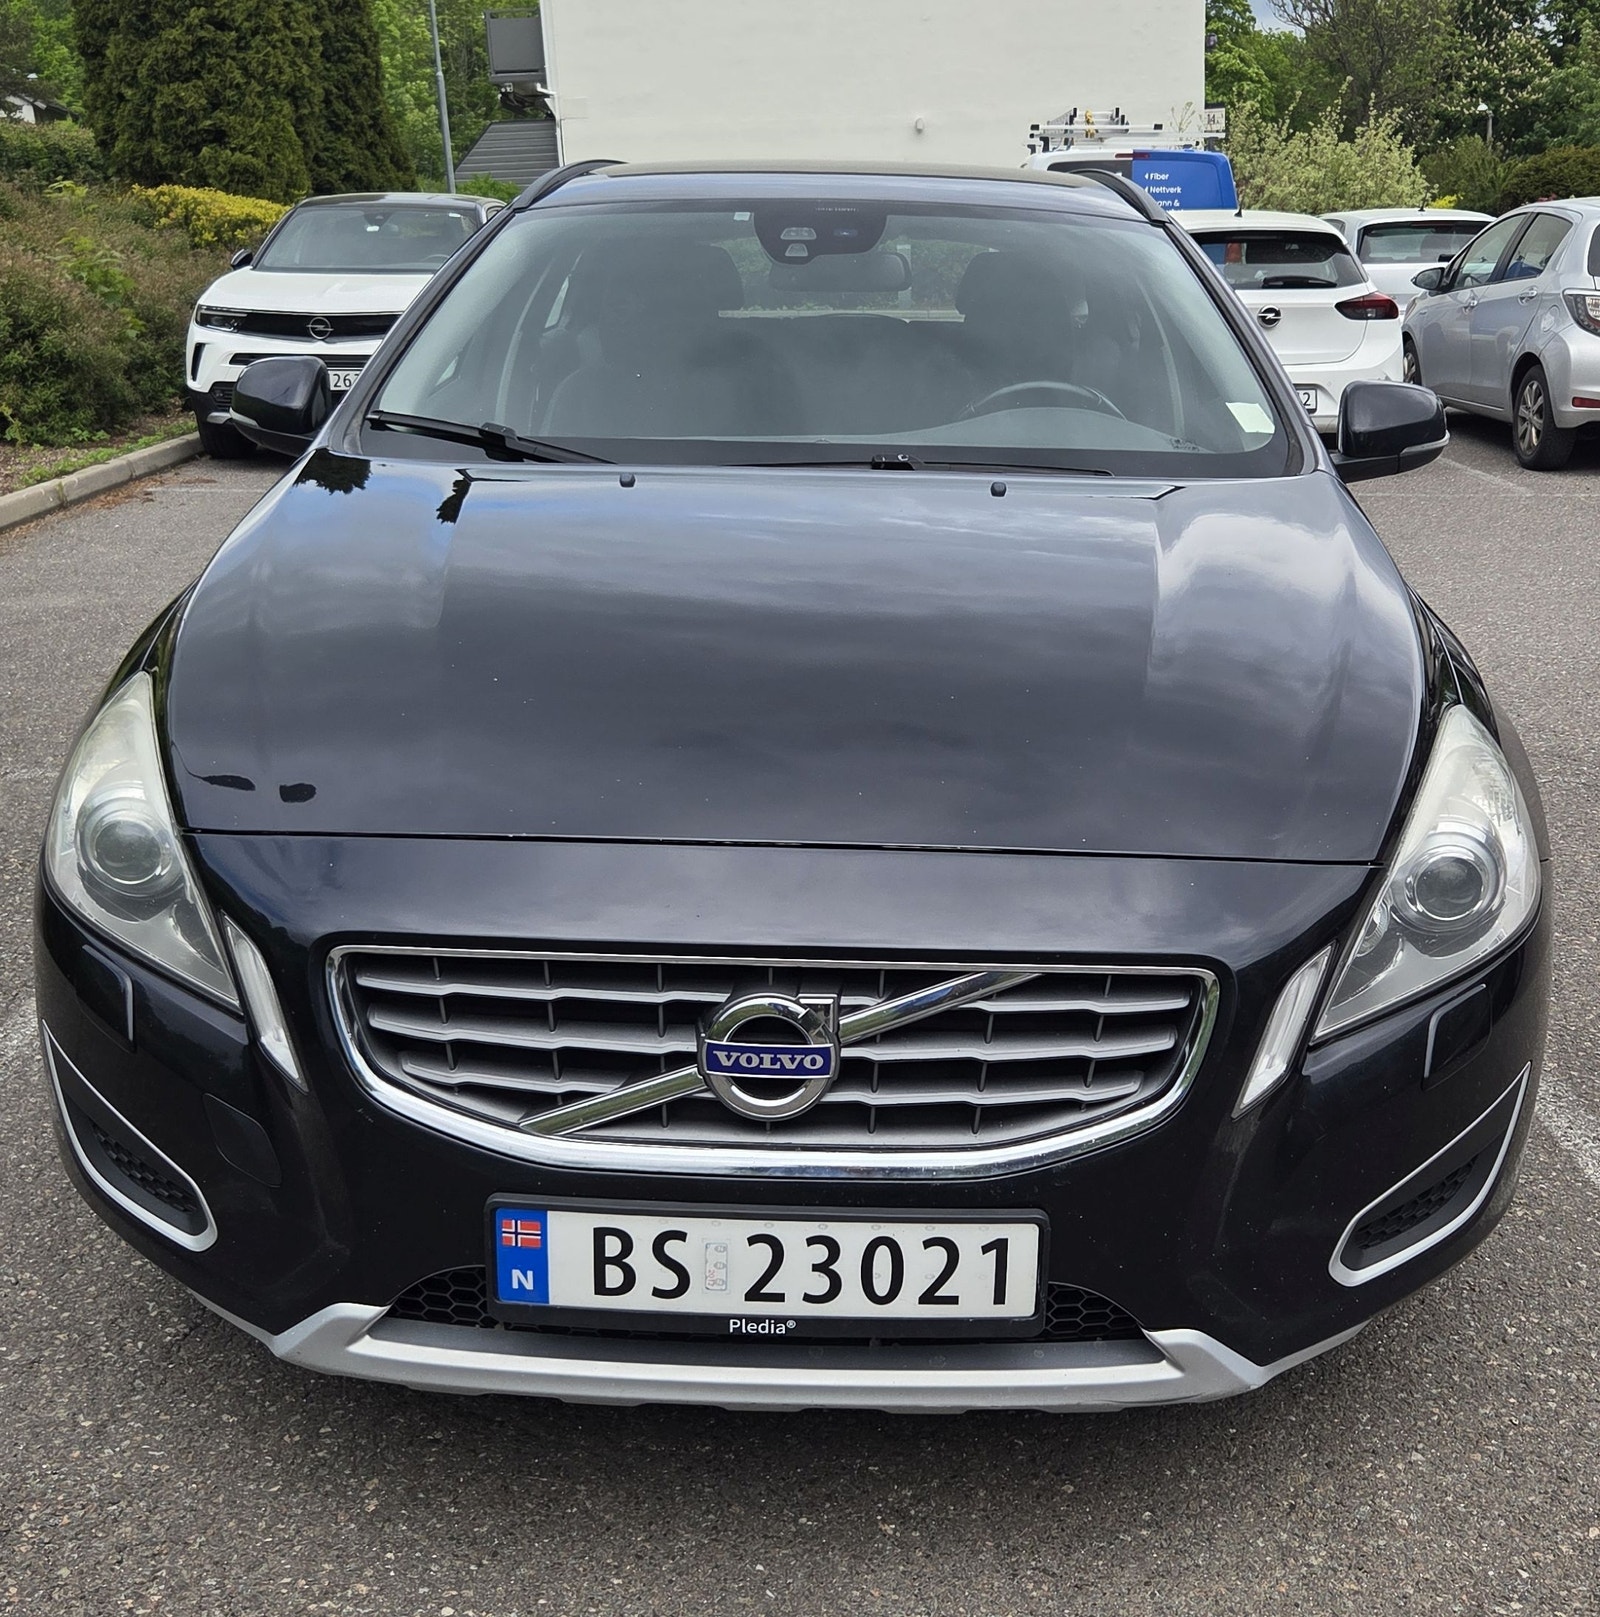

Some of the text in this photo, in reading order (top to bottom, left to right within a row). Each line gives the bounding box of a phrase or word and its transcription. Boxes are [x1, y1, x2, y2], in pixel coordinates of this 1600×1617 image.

[1150, 172, 1169, 180] Fiber
[1150, 186, 1182, 194] Nettverk
[1173, 199, 1180, 207] &
[712, 1050, 824, 1070] VOLVO
[593, 1226, 1009, 1306] BS 23021
[511, 1269, 534, 1291] N
